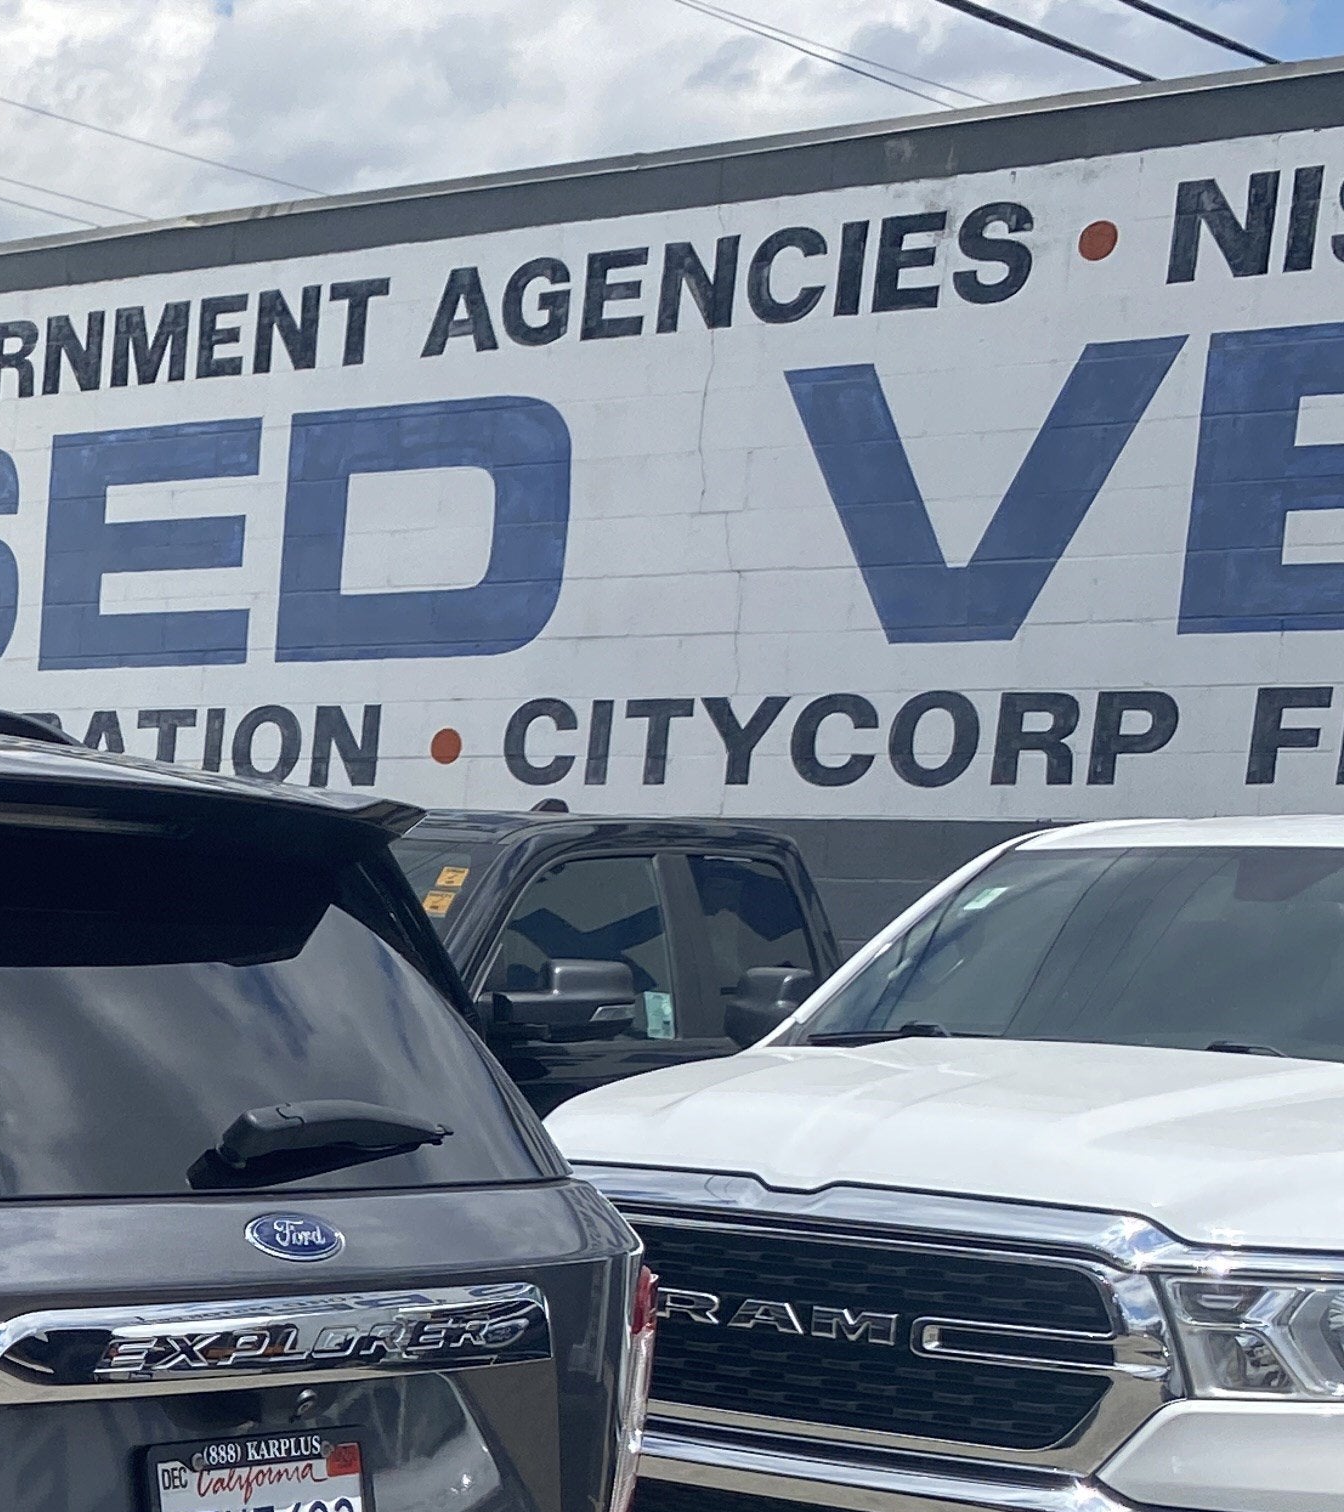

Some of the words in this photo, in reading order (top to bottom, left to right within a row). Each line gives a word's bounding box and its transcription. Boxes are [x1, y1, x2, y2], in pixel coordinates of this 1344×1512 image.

[420, 201, 1035, 358] AGENCIES
[1165, 164, 1344, 285] NI
[783, 323, 1344, 645] VE
[21, 703, 382, 787] ATION
[503, 689, 1180, 788] CITYCORP
[1244, 685, 1344, 786] F
[273, 1219, 326, 1247] Ford
[655, 1286, 898, 1347] RAM
[94, 1317, 492, 1373] EXPLORER
[161, 1466, 188, 1491] DEC
[203, 1443, 241, 1466] (888)
[246, 1436, 321, 1461] KARPLUS
[196, 1462, 328, 1505] California
